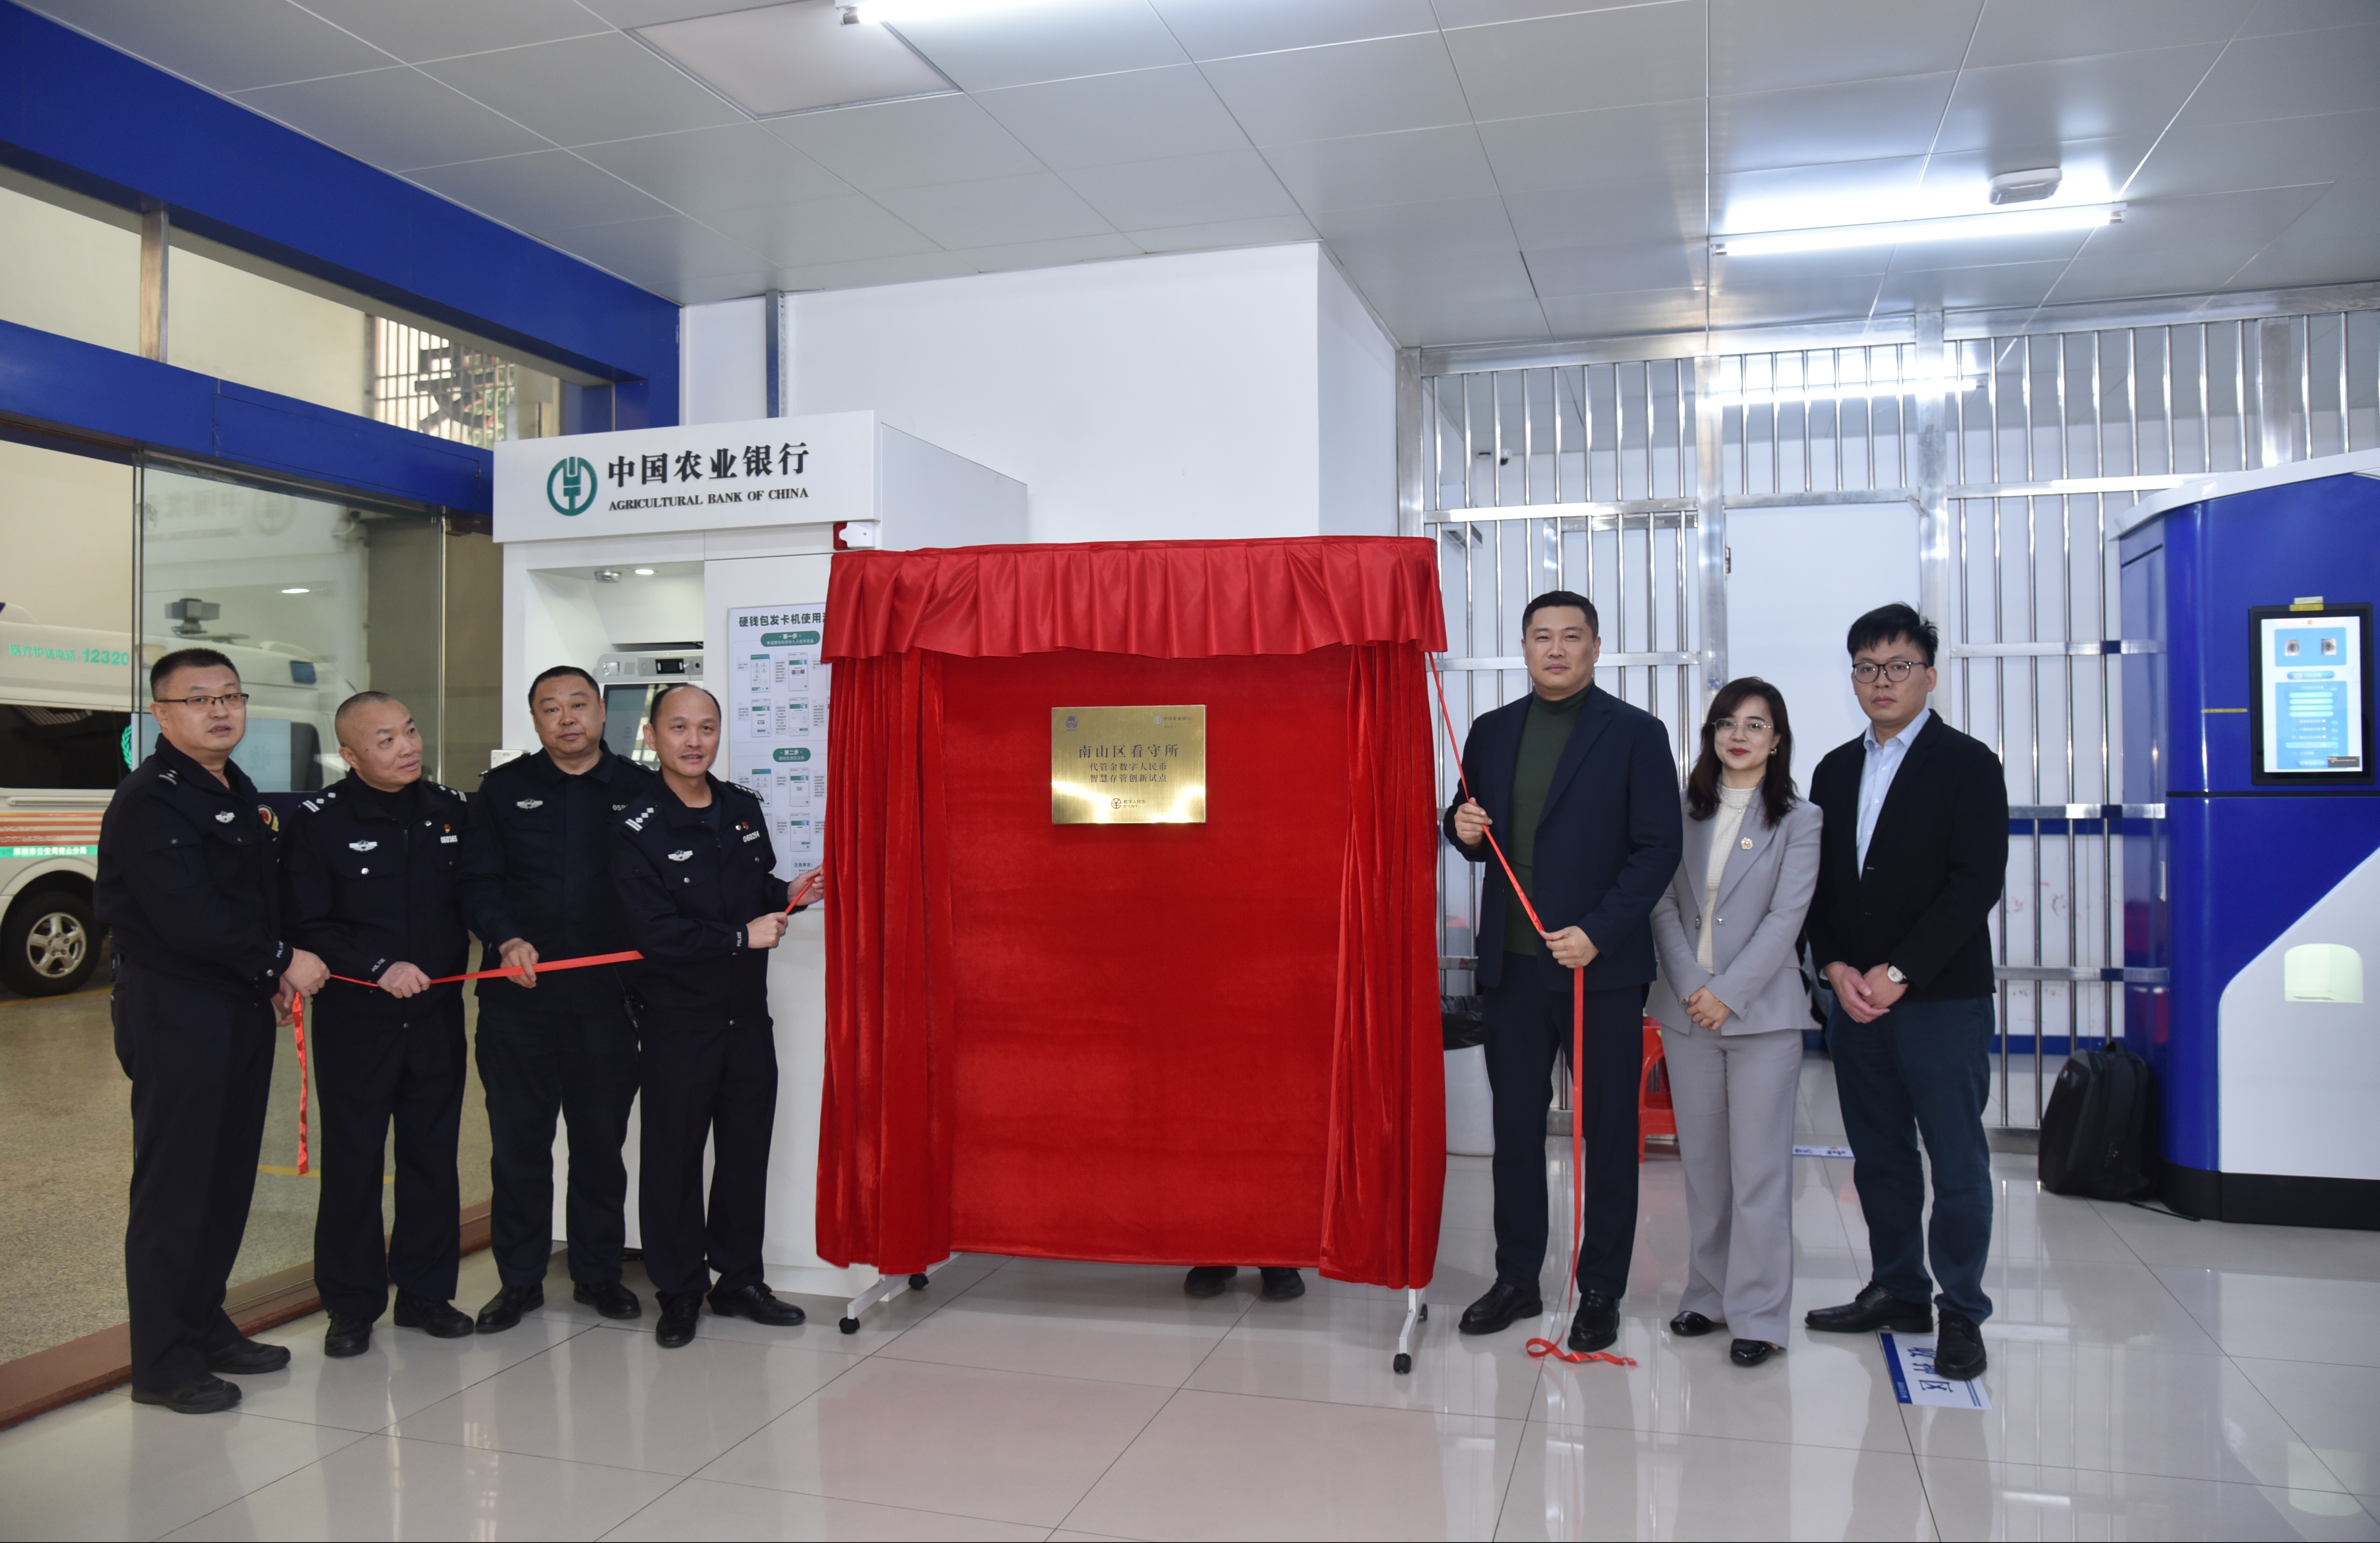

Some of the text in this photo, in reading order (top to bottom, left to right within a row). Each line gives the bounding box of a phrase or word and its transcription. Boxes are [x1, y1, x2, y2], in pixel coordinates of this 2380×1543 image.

[608, 442, 810, 488] 中国农业银行
[608, 487, 808, 511] AGRICULTURAL BANK OF CHINA
[82, 648, 129, 666] 12320
[1079, 744, 1178, 759] 南山区看守所
[1090, 762, 1167, 772] 代管金数字人民币
[1090, 774, 1168, 783] 智慧存管创新试点
